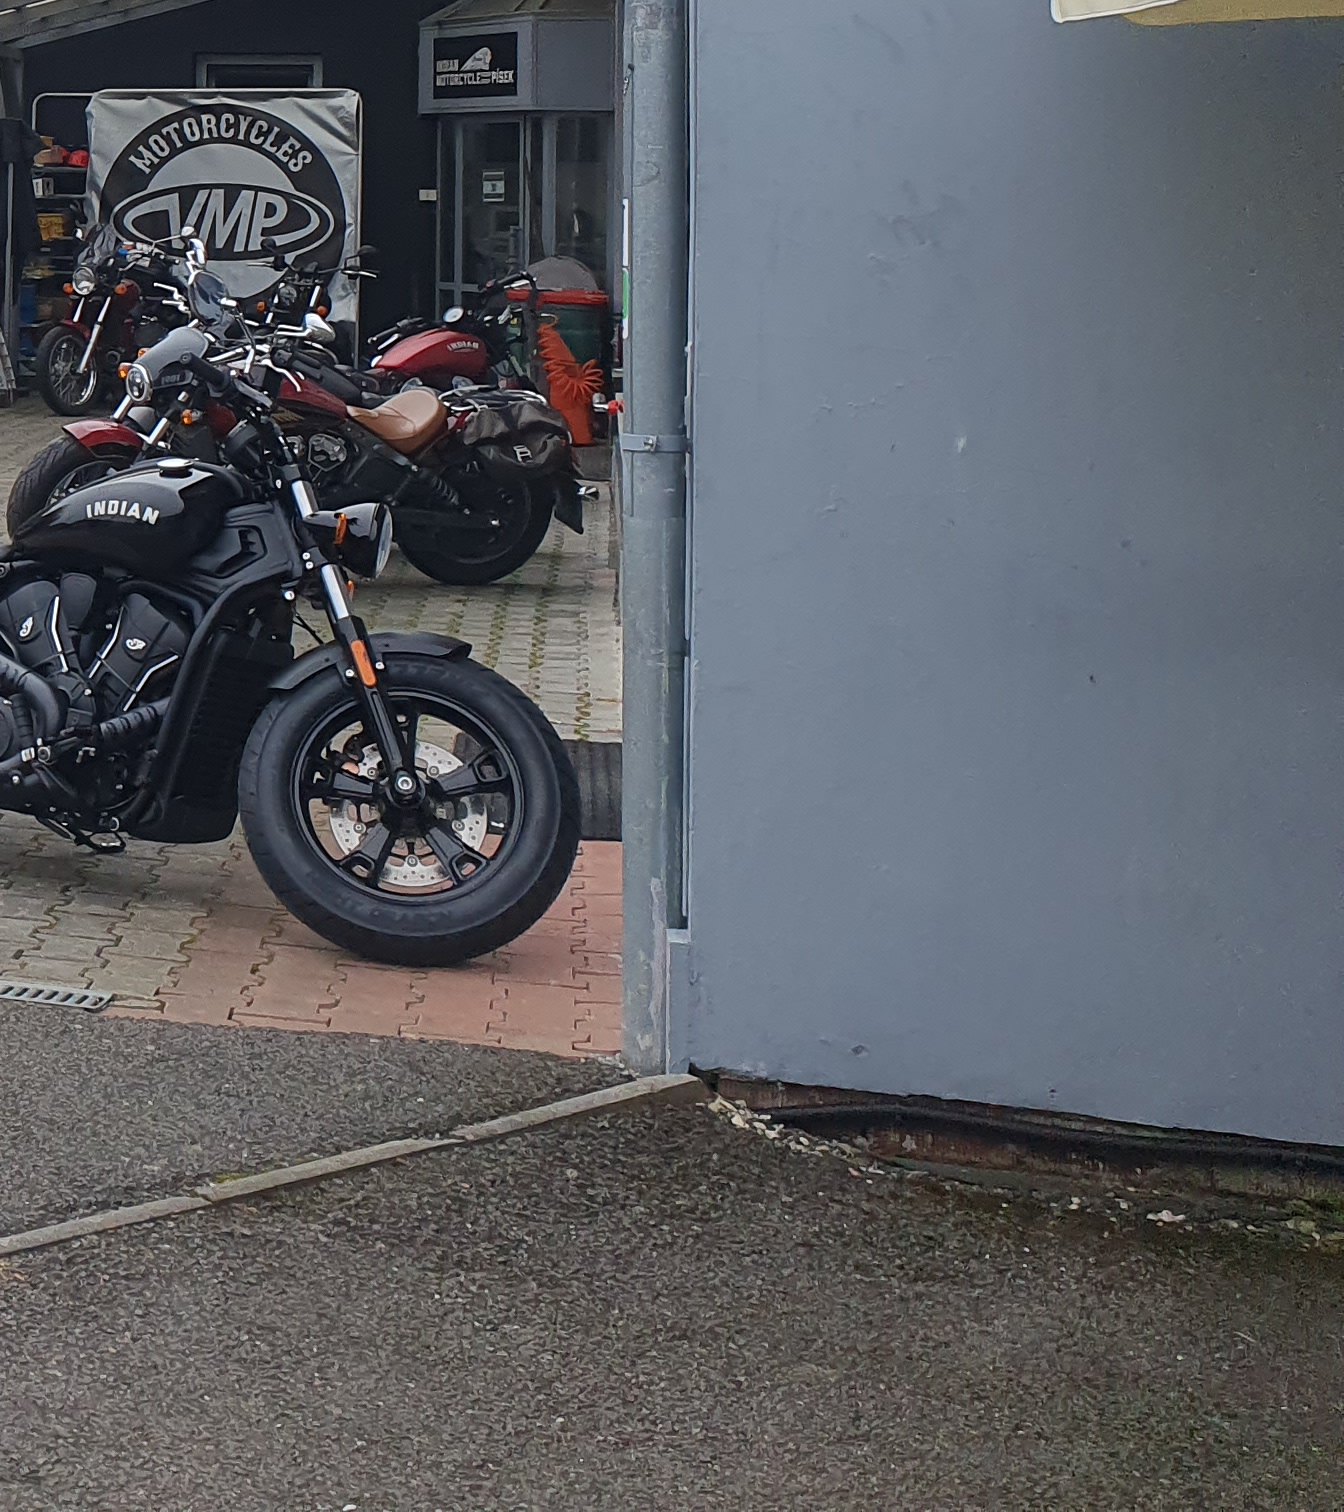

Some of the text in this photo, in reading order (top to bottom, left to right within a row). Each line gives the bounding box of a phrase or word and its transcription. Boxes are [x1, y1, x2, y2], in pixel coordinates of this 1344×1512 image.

[128, 113, 313, 175] MOTORCYCLES
[142, 188, 304, 253] VMP
[85, 499, 161, 526] INDIAN
